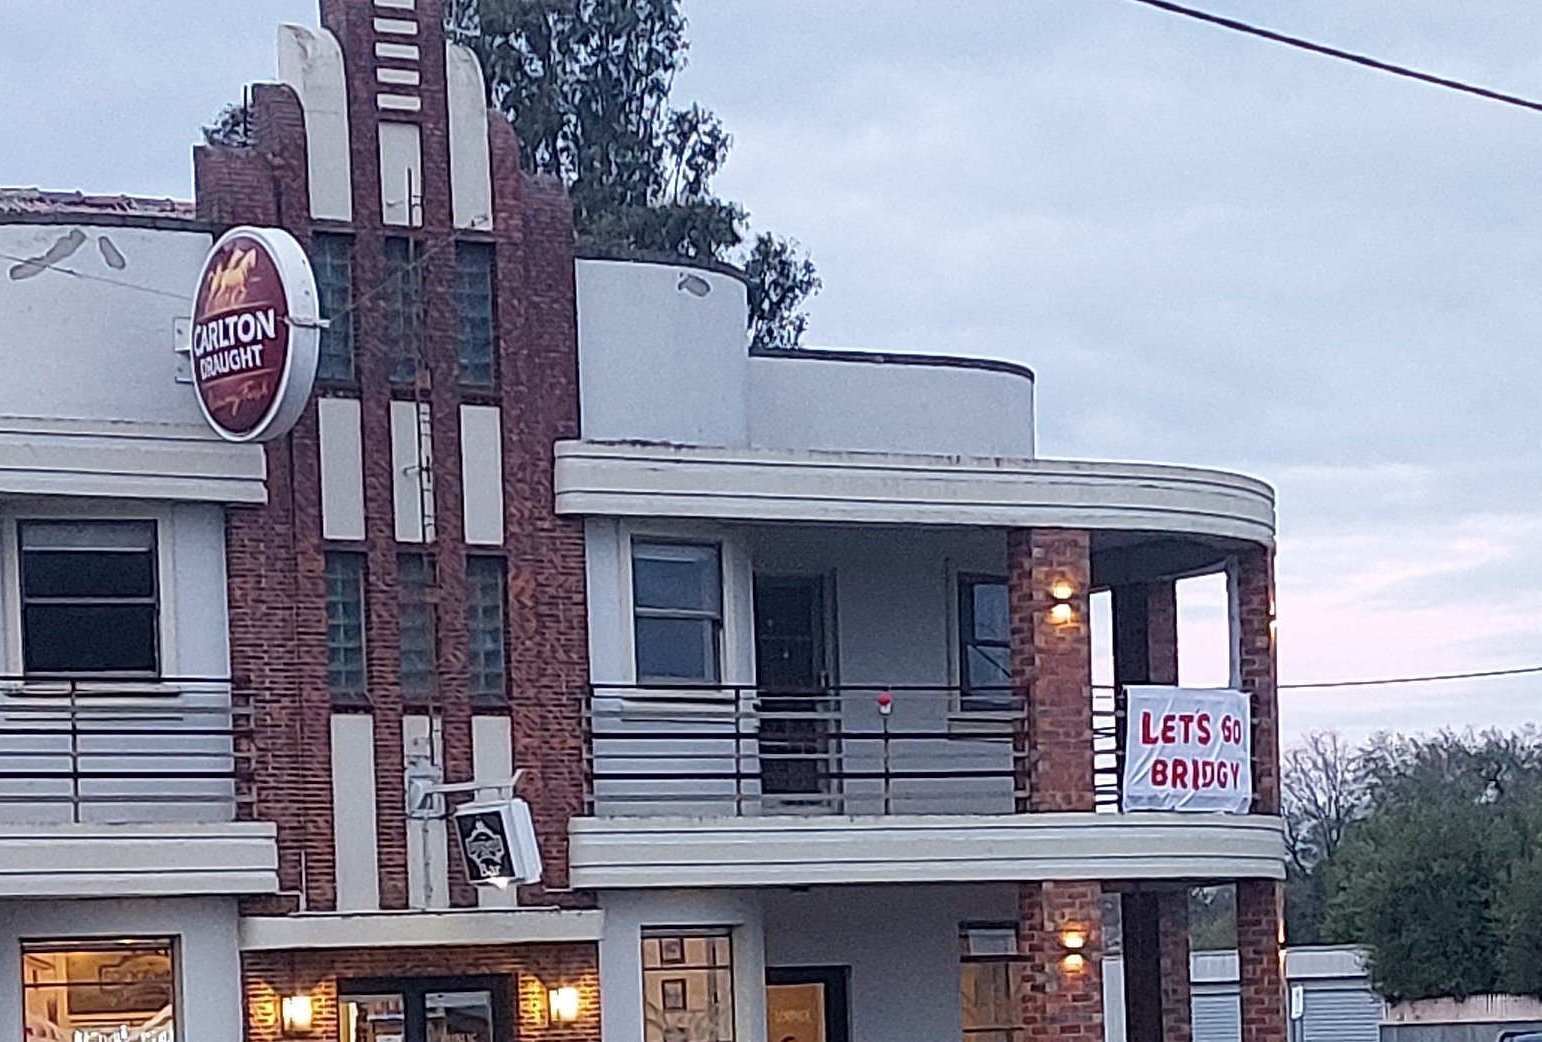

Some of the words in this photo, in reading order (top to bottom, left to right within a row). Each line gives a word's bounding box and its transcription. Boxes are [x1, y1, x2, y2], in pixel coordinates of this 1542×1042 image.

[194, 308, 276, 356] CARLTON
[200, 344, 263, 380] DRAUGHT
[1221, 715, 1241, 745] GO
[1151, 759, 1240, 790] BRIDGY
